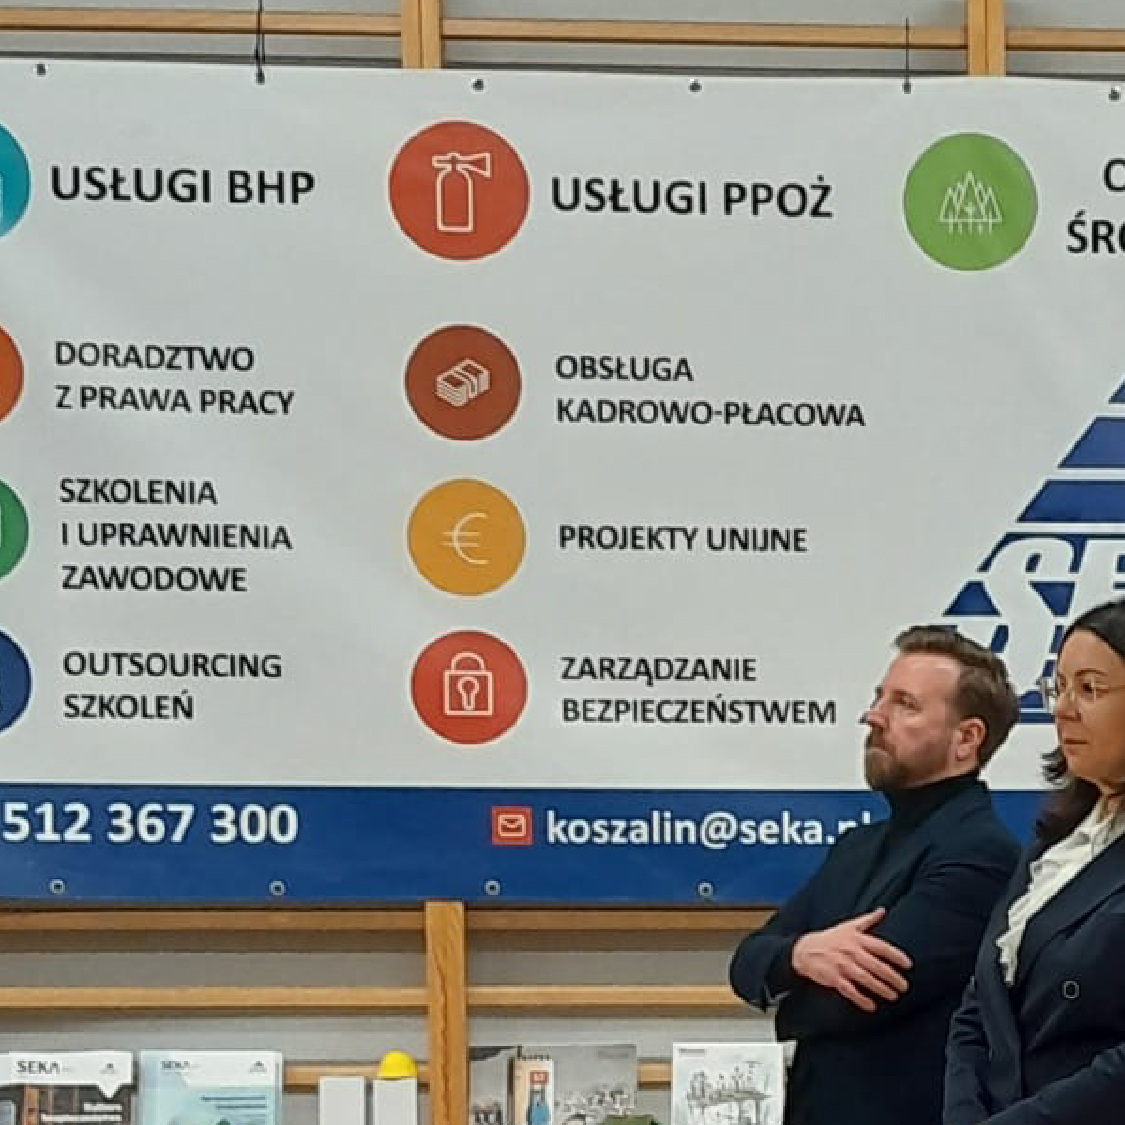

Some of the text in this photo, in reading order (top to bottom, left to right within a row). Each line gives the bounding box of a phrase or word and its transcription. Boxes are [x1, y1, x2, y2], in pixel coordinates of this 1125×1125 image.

[52, 166, 316, 205] USŁUGI BHP
[551, 174, 833, 218] USŁUGI PPOŻ
[55, 340, 255, 373] DORADZTWO
[556, 354, 695, 382] OBSŁUGA
[55, 384, 295, 417] Z PRAWA PRACY
[557, 397, 867, 428] KADROWO-PŁACOWA
[59, 478, 219, 505] SZKOLENIA
[61, 522, 293, 550] I UPRAWNIENIA
[559, 525, 808, 553] PROJEKTY UNIJNE
[61, 565, 248, 592] ZAWODOWE
[62, 650, 282, 678] OUTSOURCING
[561, 656, 757, 687] ZARZĄDZANIE
[64, 686, 193, 720] SZKOLEŃ
[563, 691, 837, 724] BEZPIECZEŃSTWEM
[2, 801, 299, 845] 512 367 300
